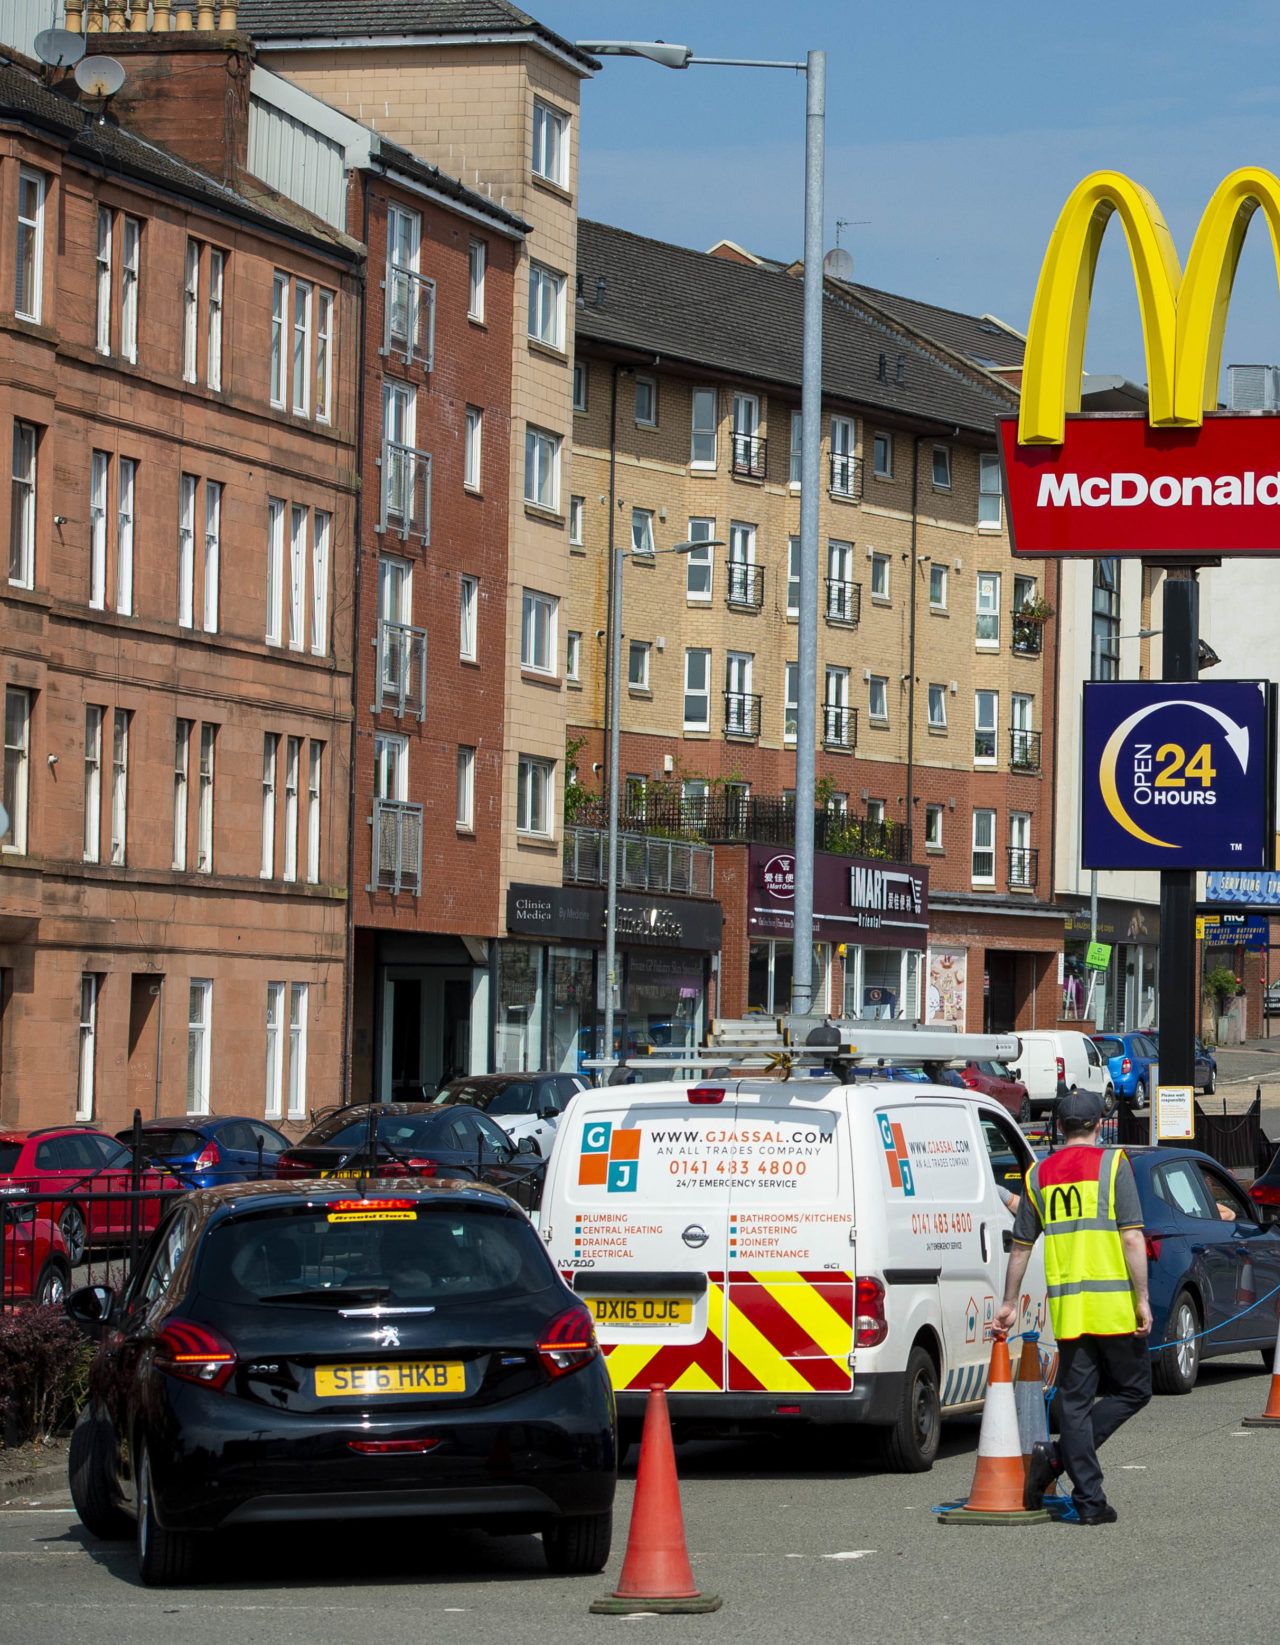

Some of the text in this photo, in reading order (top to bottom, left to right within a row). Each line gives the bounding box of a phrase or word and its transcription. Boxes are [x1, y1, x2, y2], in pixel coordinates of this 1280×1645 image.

[1154, 743, 1217, 787] 24
[1133, 743, 1152, 805] OPEN
[1154, 790, 1217, 805] HOURS
[1230, 843, 1243, 851] TM
[1221, 876, 1260, 892] SERVICING
[516, 899, 551, 910] Clinica
[516, 910, 551, 922] Medica
[858, 912, 881, 928] Oriental
[586, 1126, 605, 1148] G
[651, 1131, 833, 1144] WWW.GJASSAL.COM
[657, 1146, 822, 1156] AN ALL TRADES COMPANY
[669, 1160, 807, 1175] 0141 483 4800
[616, 1165, 631, 1188] J
[676, 1179, 697, 1189] 24/7
[758, 1179, 798, 1189] SERVICE
[583, 1214, 628, 1223] PLUMBING
[739, 1214, 852, 1223] BATHROOMS/KITCHENS
[911, 1212, 972, 1235] 0141 483 4800
[582, 1226, 663, 1235] CENTRAL HEATING
[739, 1226, 798, 1235] PLASTERING
[582, 1238, 628, 1246] DRAINAGE
[739, 1238, 780, 1247] JOINERY
[582, 1250, 634, 1258] ELECTRICAL
[739, 1250, 810, 1258] MAINTENANCE
[595, 1300, 680, 1319] DX16 OJC
[333, 1363, 448, 1390] SE16 HKB
